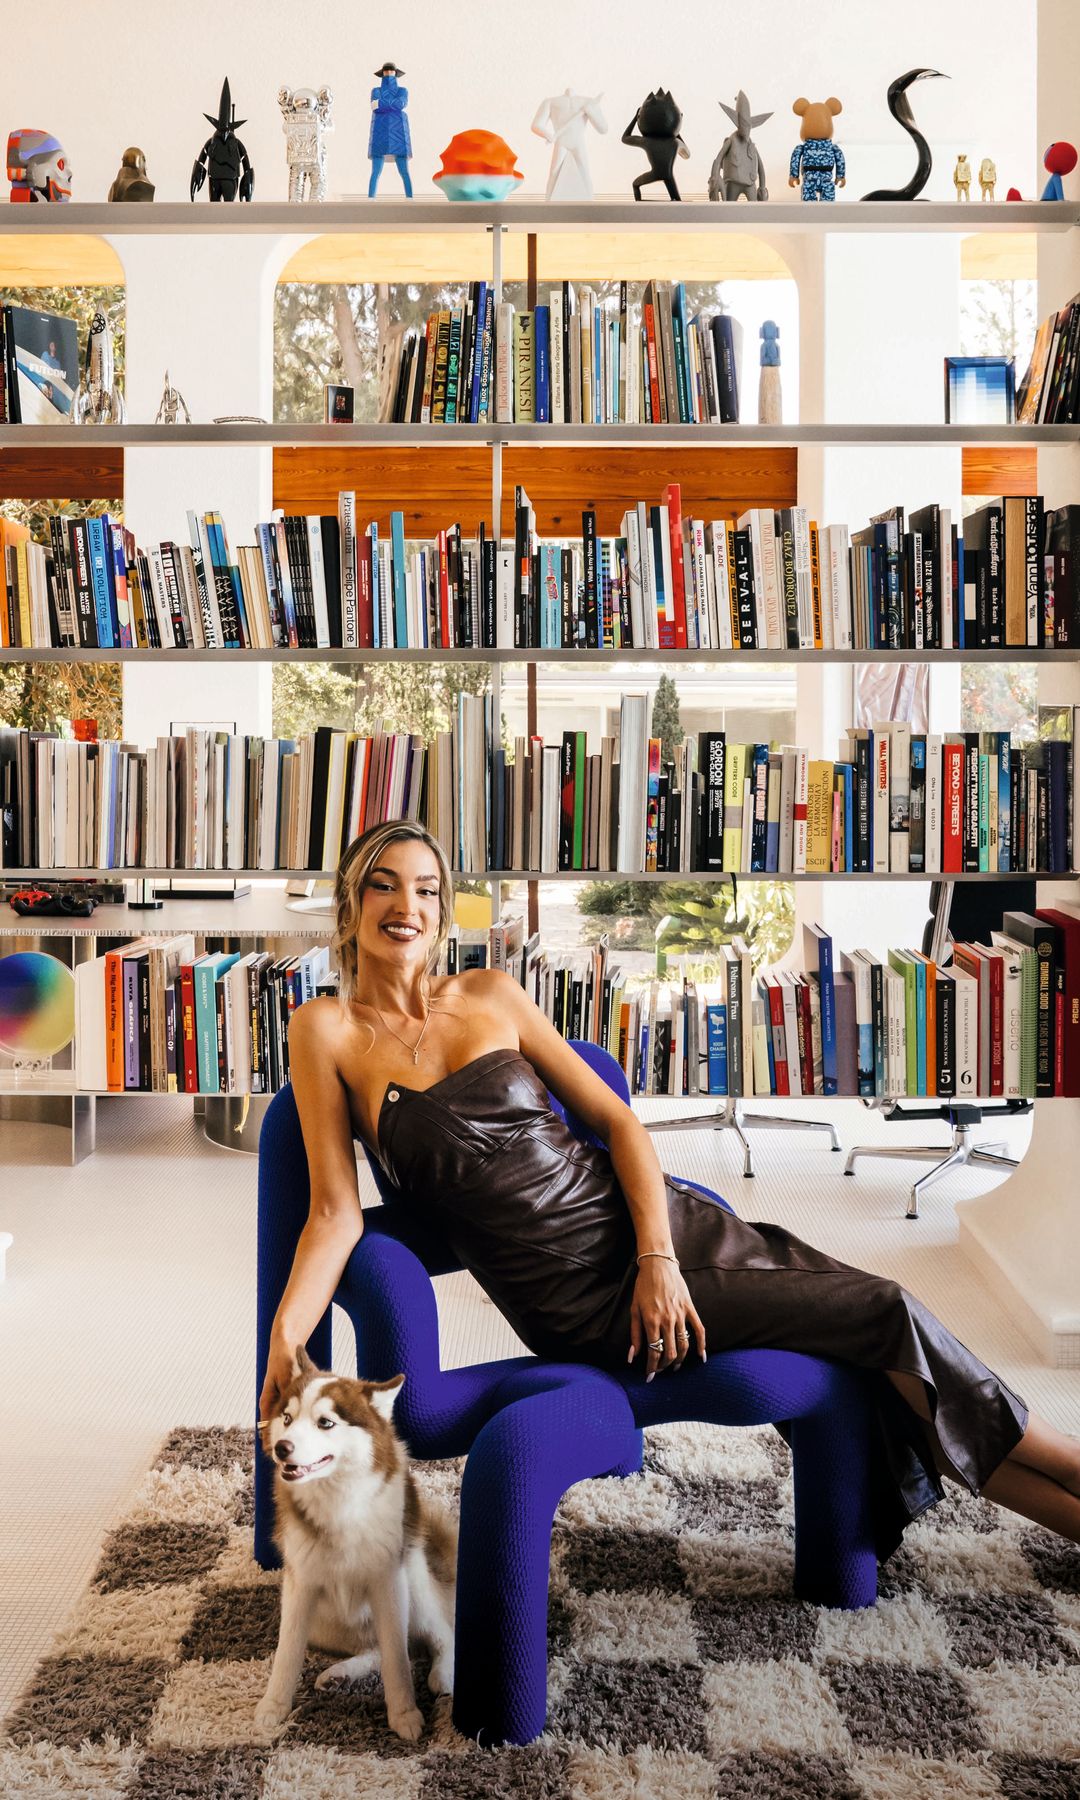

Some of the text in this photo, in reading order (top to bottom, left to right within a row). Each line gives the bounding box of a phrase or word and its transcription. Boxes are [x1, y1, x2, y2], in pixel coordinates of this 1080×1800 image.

[437, 322, 450, 344] AKIRA
[450, 321, 461, 343] AKIRA
[483, 330, 491, 355] WORLD
[481, 356, 489, 387] RECORDS
[519, 337, 531, 413] PIRANESI
[92, 523, 101, 551] URBAN
[343, 497, 356, 642] Praesentia Felipe Pantone
[588, 557, 594, 566] my
[729, 558, 735, 568] OF
[812, 557, 817, 567] OF
[784, 531, 796, 616] CHAZ BOJÓRQUEZ
[1027, 566, 1037, 599] Yann
[154, 561, 166, 609] MURAL MASTERS
[169, 576, 180, 614] EUROPEAN
[715, 741, 723, 785] GORDON
[755, 764, 767, 821] KENNY SCHARF
[808, 783, 814, 793] DE
[951, 753, 960, 836] BEYOND STREETS
[814, 826, 820, 836] LA
[821, 815, 828, 825] LA
[821, 826, 828, 837] DE
[730, 966, 738, 998] Poltrona
[1039, 962, 1049, 991] GUMBALL
[1040, 992, 1049, 1010] 3000
[1039, 1019, 1049, 1038] YEARS
[993, 1041, 1002, 1065] PORSCHE
[1039, 1039, 1049, 1047] ON
[1039, 1047, 1048, 1058] THE
[940, 1069, 951, 1084] 5
[1039, 1058, 1048, 1073] ROAD
[960, 1070, 972, 1085] 6
